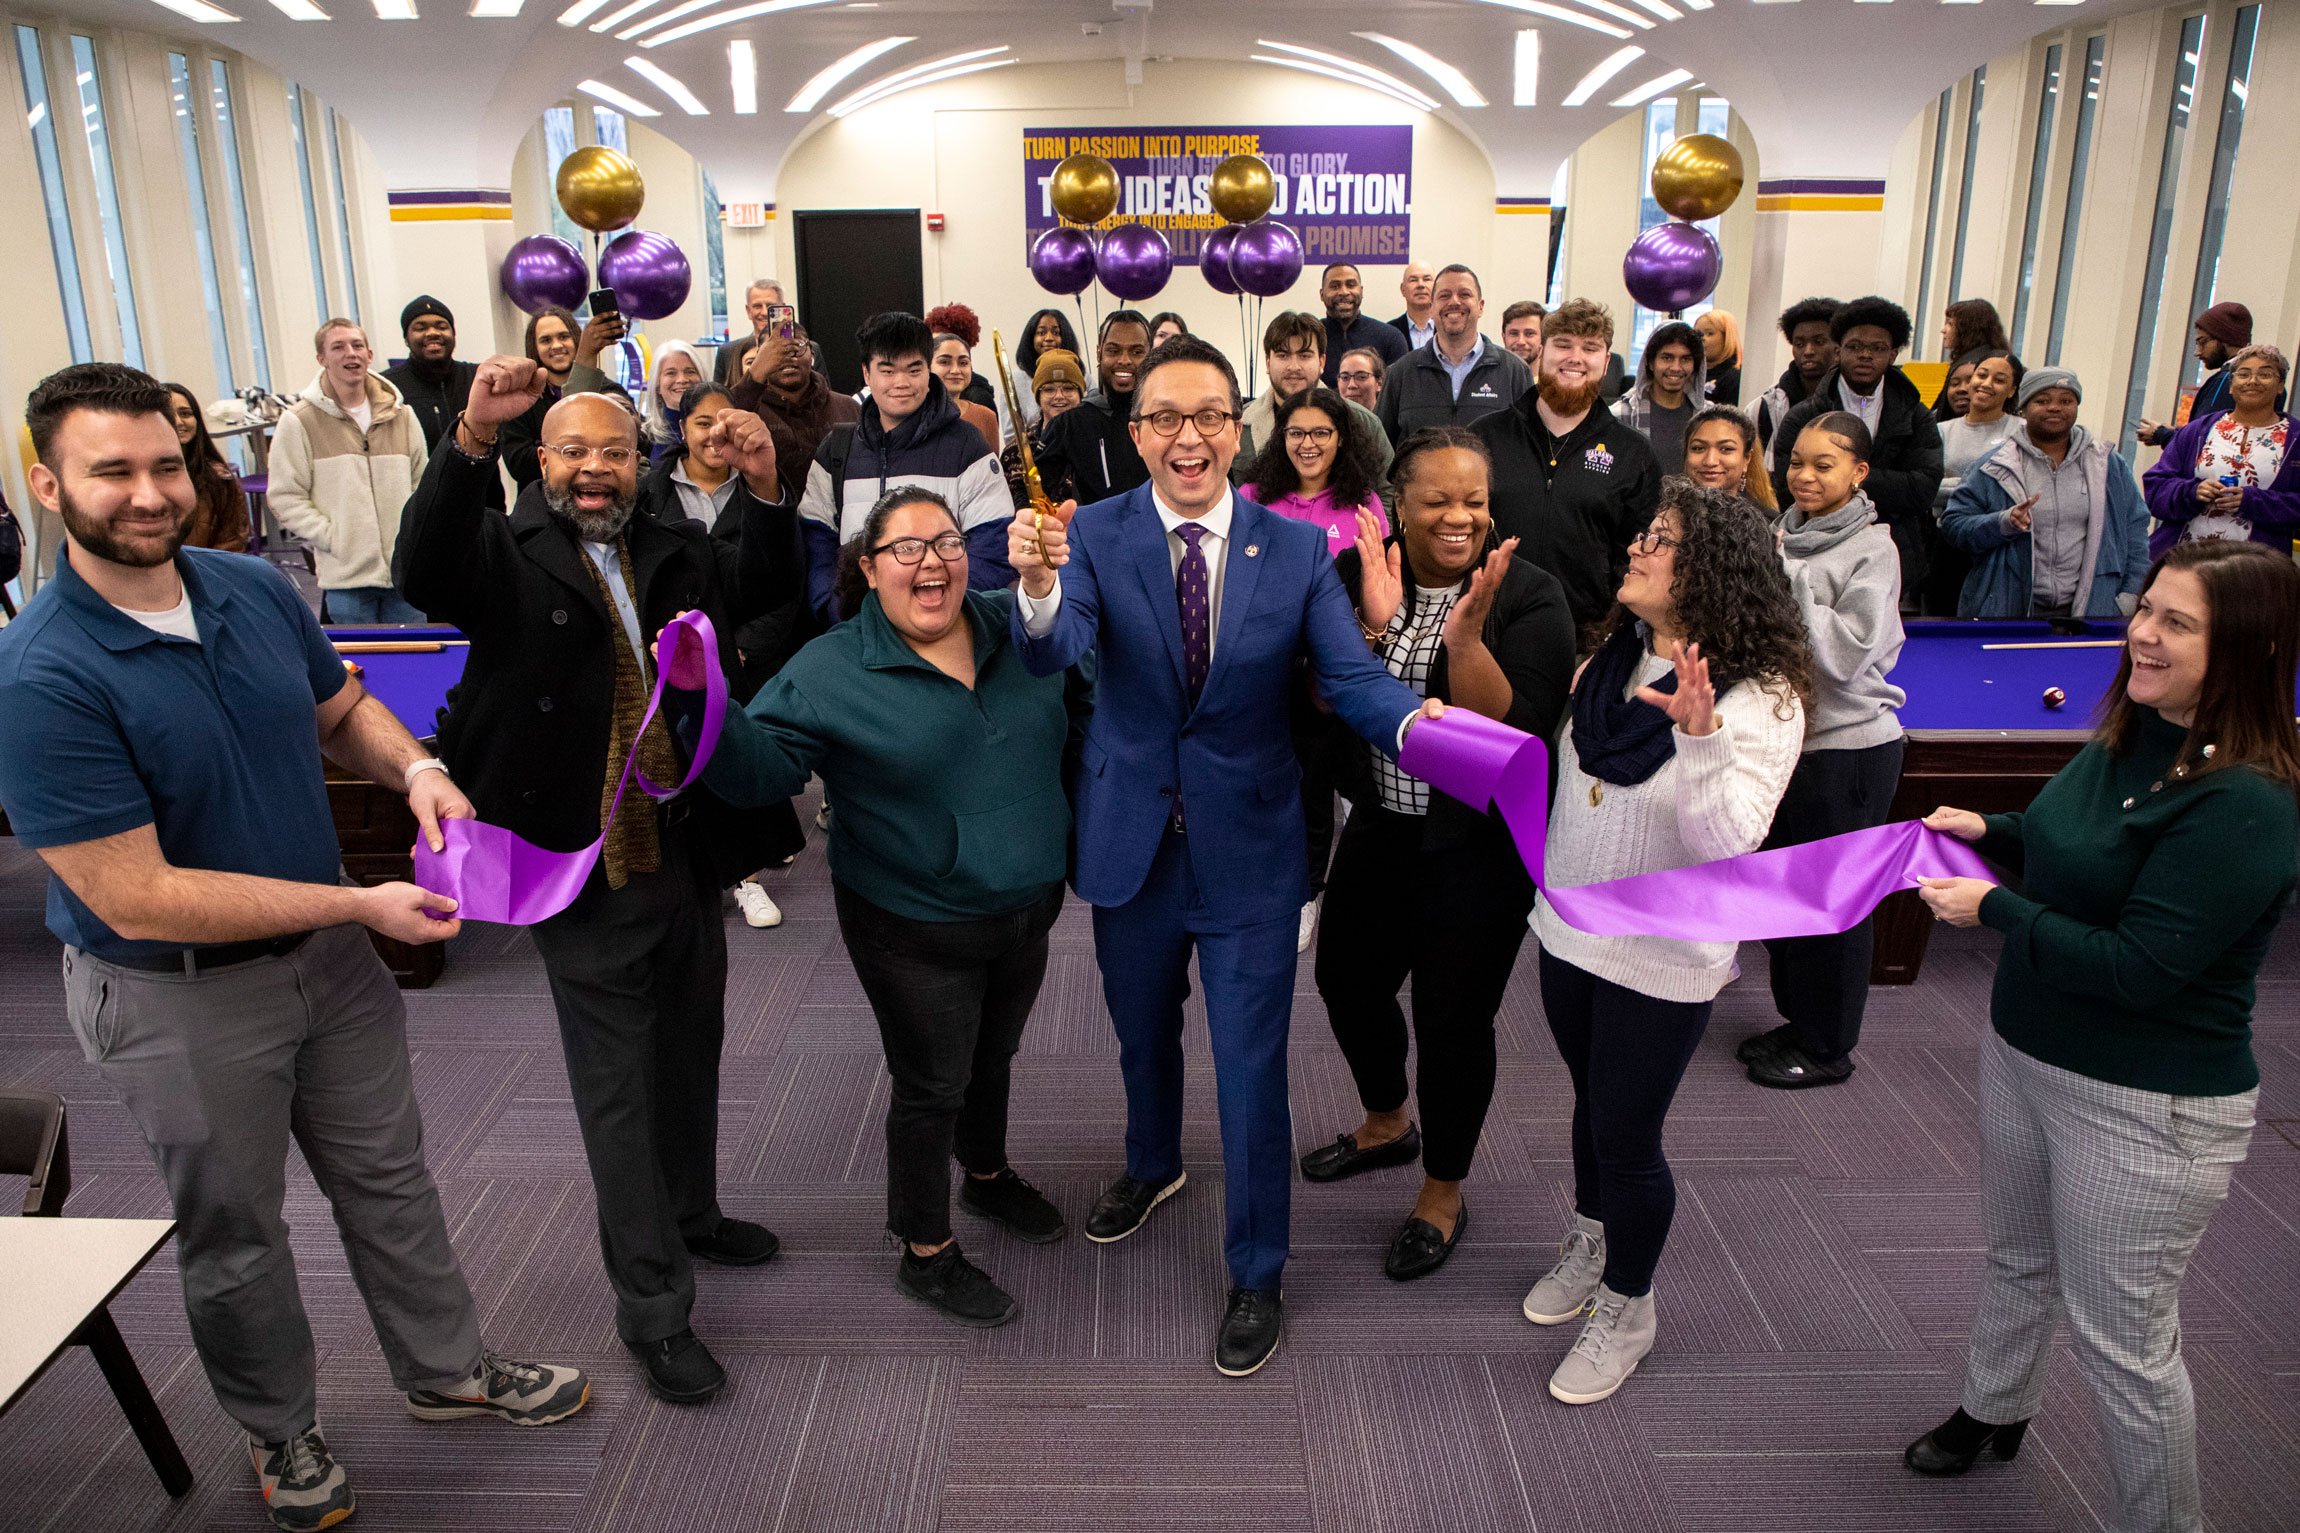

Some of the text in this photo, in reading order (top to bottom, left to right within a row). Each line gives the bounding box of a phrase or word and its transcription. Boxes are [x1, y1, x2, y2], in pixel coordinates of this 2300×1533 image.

[1023, 135, 1265, 160] TURN PASSION INTO PURPOSE.
[1147, 154, 1194, 178] TURN
[1290, 153, 1351, 178] GLORY.
[1125, 175, 1213, 216] IDEAS
[1295, 173, 1411, 216] ACTION.
[732, 203, 759, 225] EXIT
[1305, 225, 1410, 256] PROMISE.
